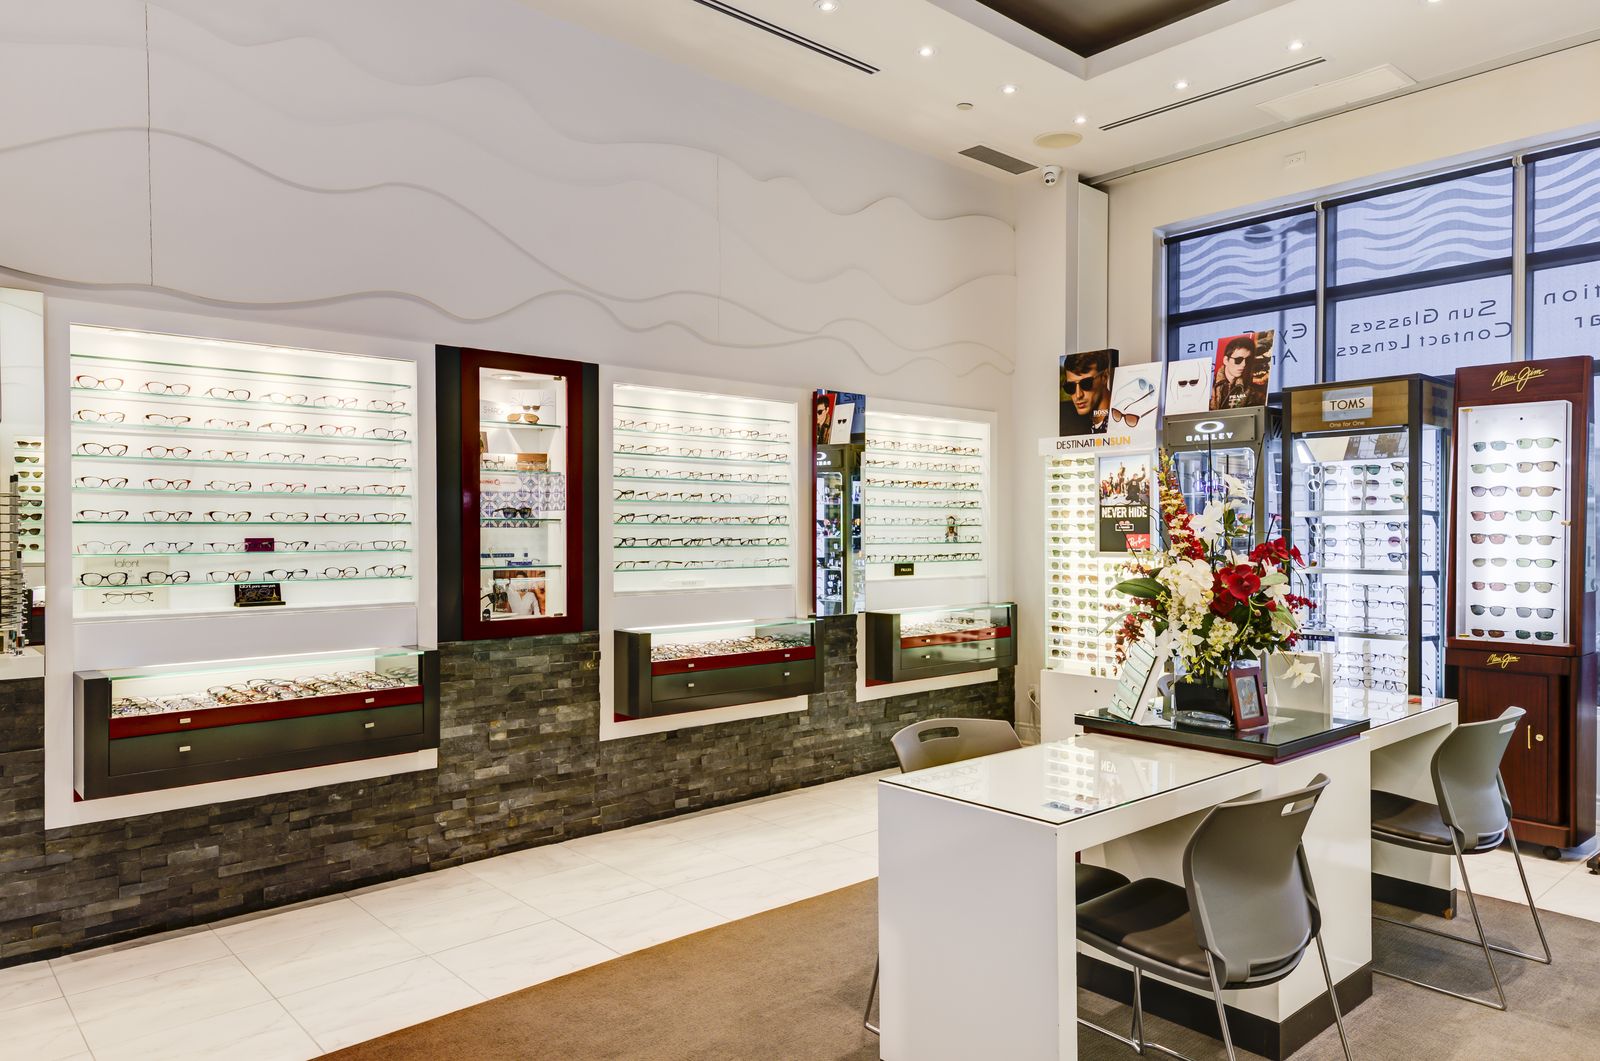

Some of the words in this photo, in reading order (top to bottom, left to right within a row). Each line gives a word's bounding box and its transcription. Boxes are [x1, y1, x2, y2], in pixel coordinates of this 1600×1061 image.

[1491, 369, 1517, 387] Maui
[1516, 366, 1548, 392] Jim
[1330, 398, 1365, 411] TOMS
[1185, 432, 1234, 442] OAKLEY
[1101, 506, 1127, 518] NEVER
[1128, 506, 1148, 518] HIDE
